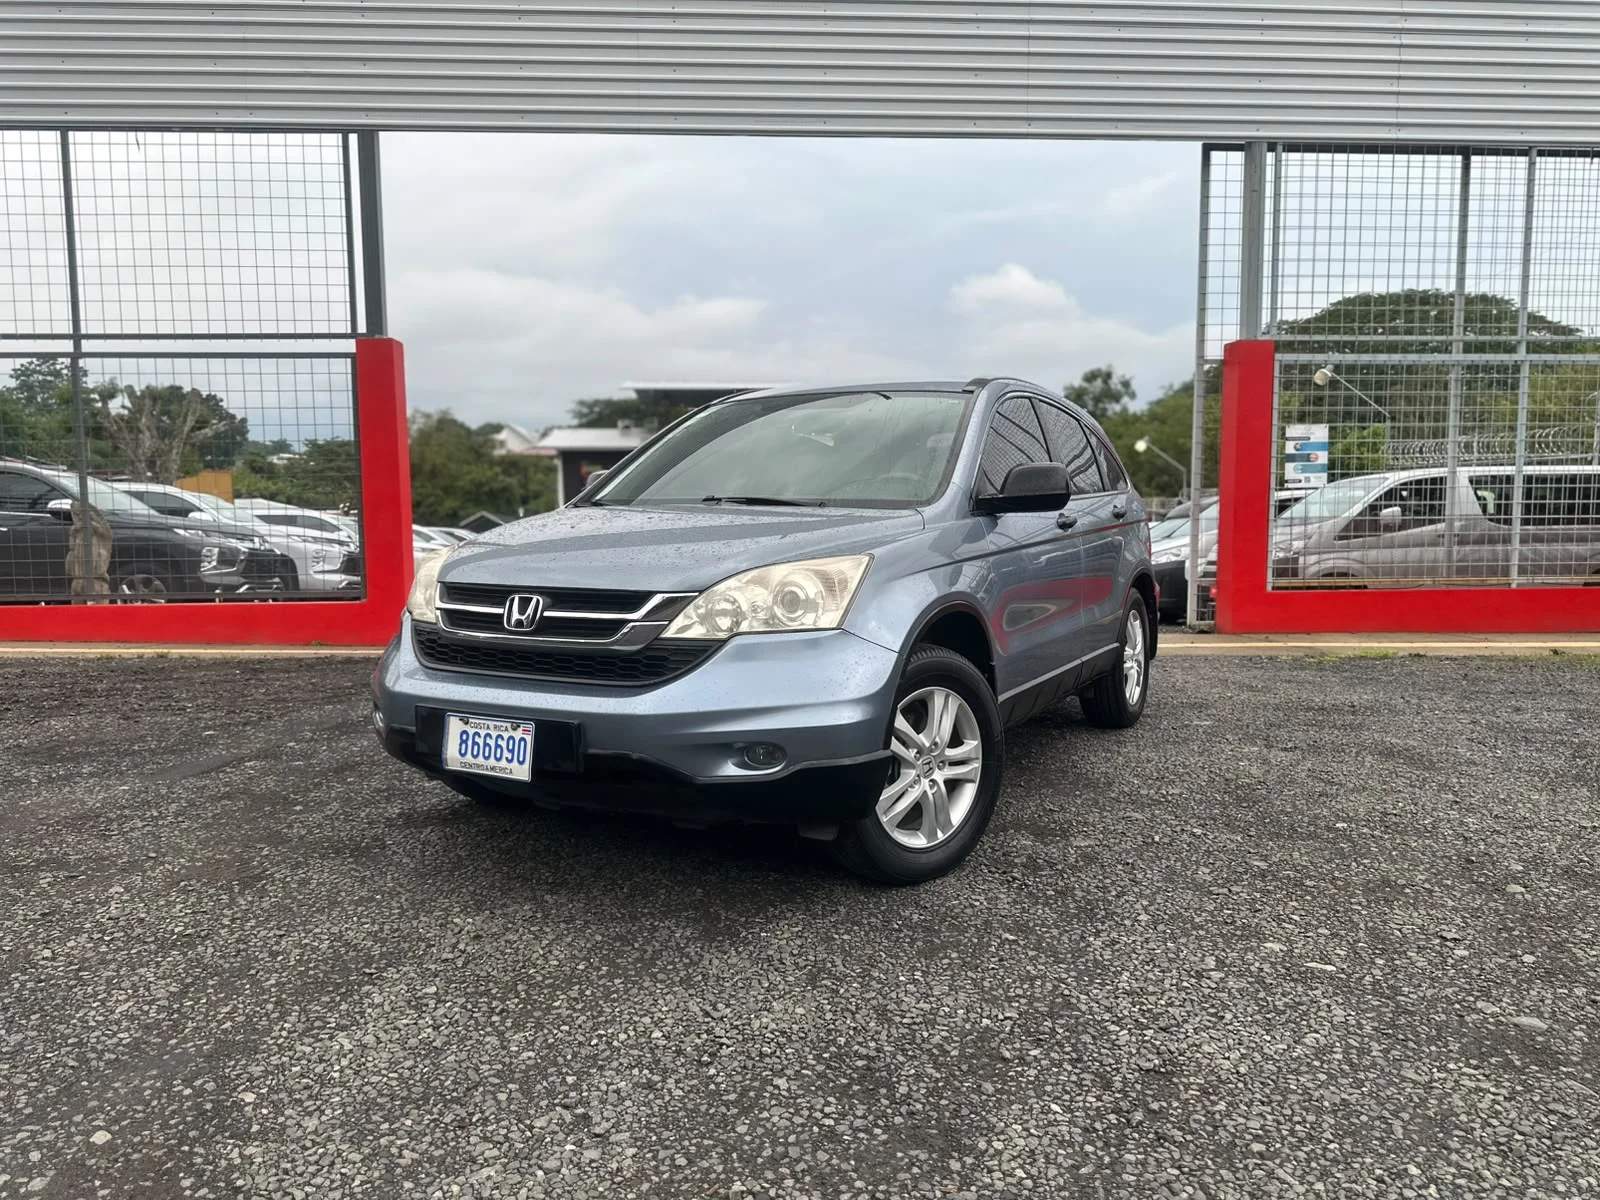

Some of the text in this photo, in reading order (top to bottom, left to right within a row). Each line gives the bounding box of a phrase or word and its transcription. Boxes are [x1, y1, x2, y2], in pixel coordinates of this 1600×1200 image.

[469, 721, 509, 732] COSTA RICA
[458, 729, 528, 766] 866690
[459, 761, 513, 775] CENTROAMERICA
